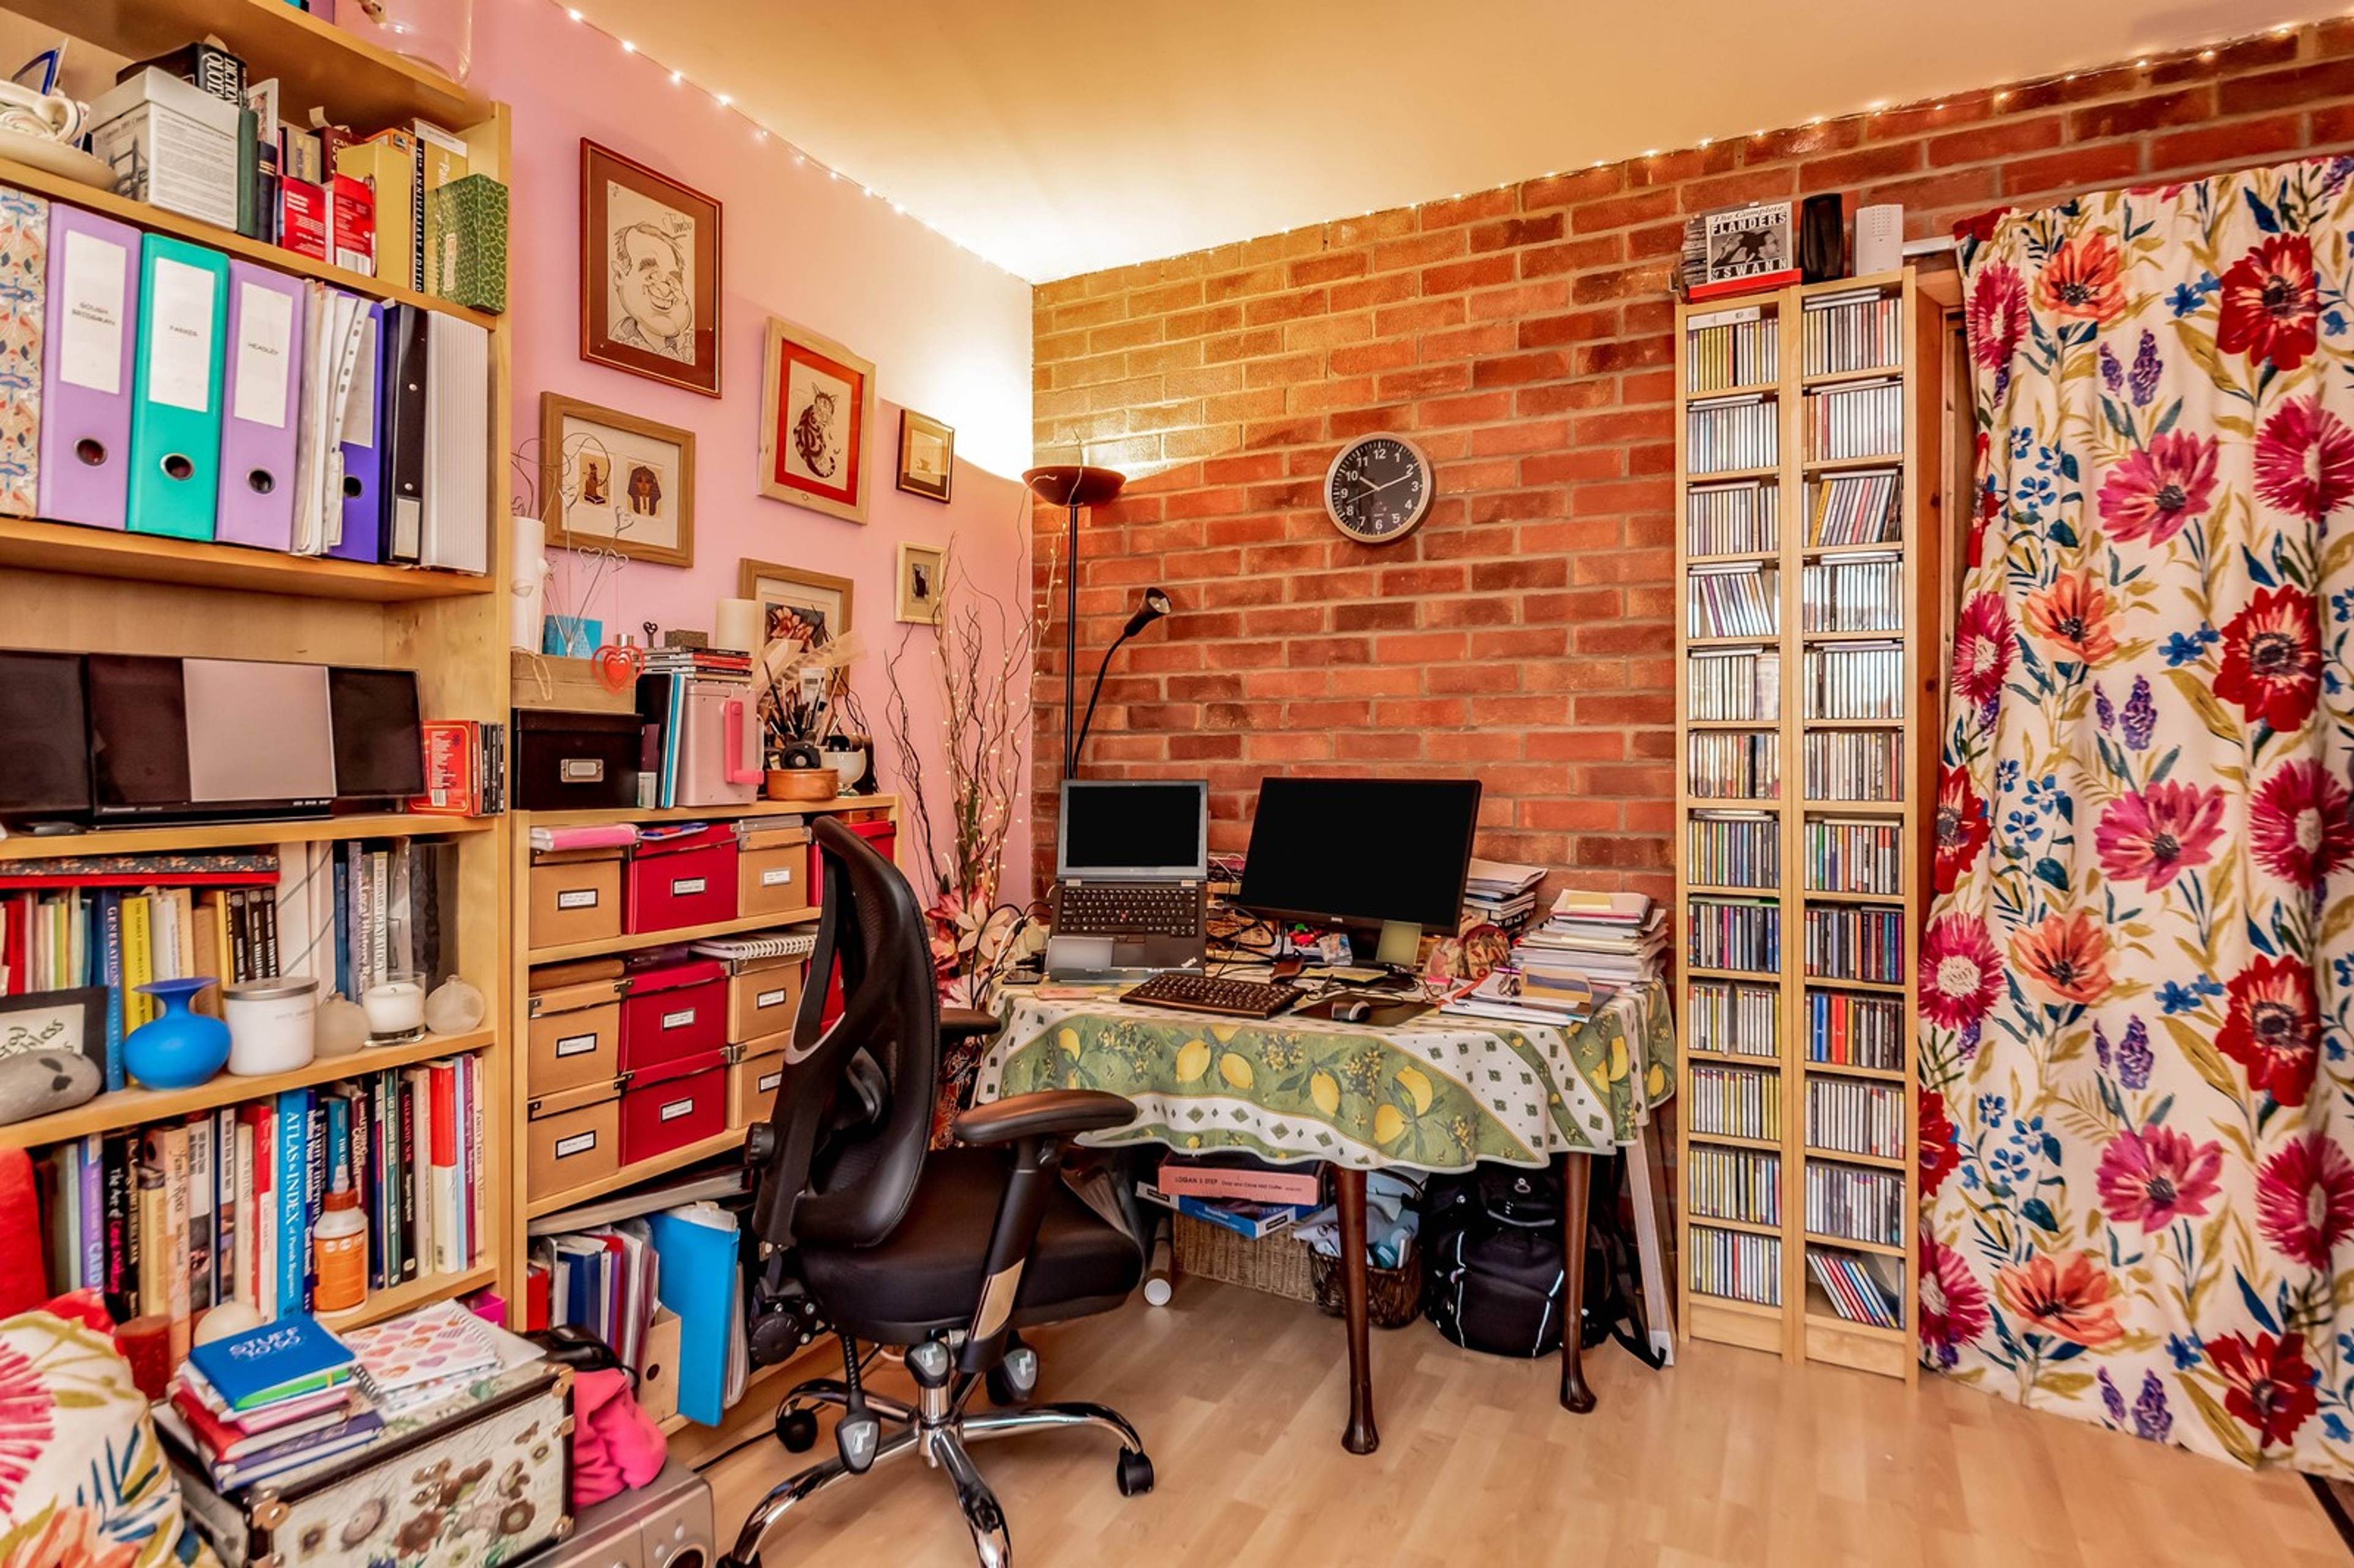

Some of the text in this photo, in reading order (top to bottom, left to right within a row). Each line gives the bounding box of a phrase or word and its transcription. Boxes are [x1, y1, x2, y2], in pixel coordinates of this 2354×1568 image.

[1735, 206, 1783, 218] Complete
[1711, 212, 1787, 236] FLANDERS
[1723, 259, 1788, 278] SWANN
[1373, 449, 1386, 460] 12
[1394, 452, 1401, 463] 1
[1357, 457, 1368, 467] 11
[1346, 470, 1358, 481] 10
[1406, 464, 1414, 475] 2
[1411, 481, 1419, 492] 3
[1341, 488, 1349, 499] 9
[1346, 505, 1354, 516] 8
[1404, 499, 1413, 510] 4
[1359, 516, 1366, 527] 7
[1392, 513, 1401, 523] 5
[1375, 519, 1383, 530] 6
[359, 885, 370, 917] Local
[107, 906, 119, 988] GENERATIONS
[357, 919, 371, 964] History
[403, 1094, 413, 1143] CALLIGRAPHY
[286, 1112, 300, 1163] ATLAS
[109, 1167, 124, 1186] The
[109, 1189, 122, 1206] Art
[285, 1173, 300, 1225] INDEX
[288, 1236, 297, 1262] Parish
[88, 1242, 103, 1285] CARD
